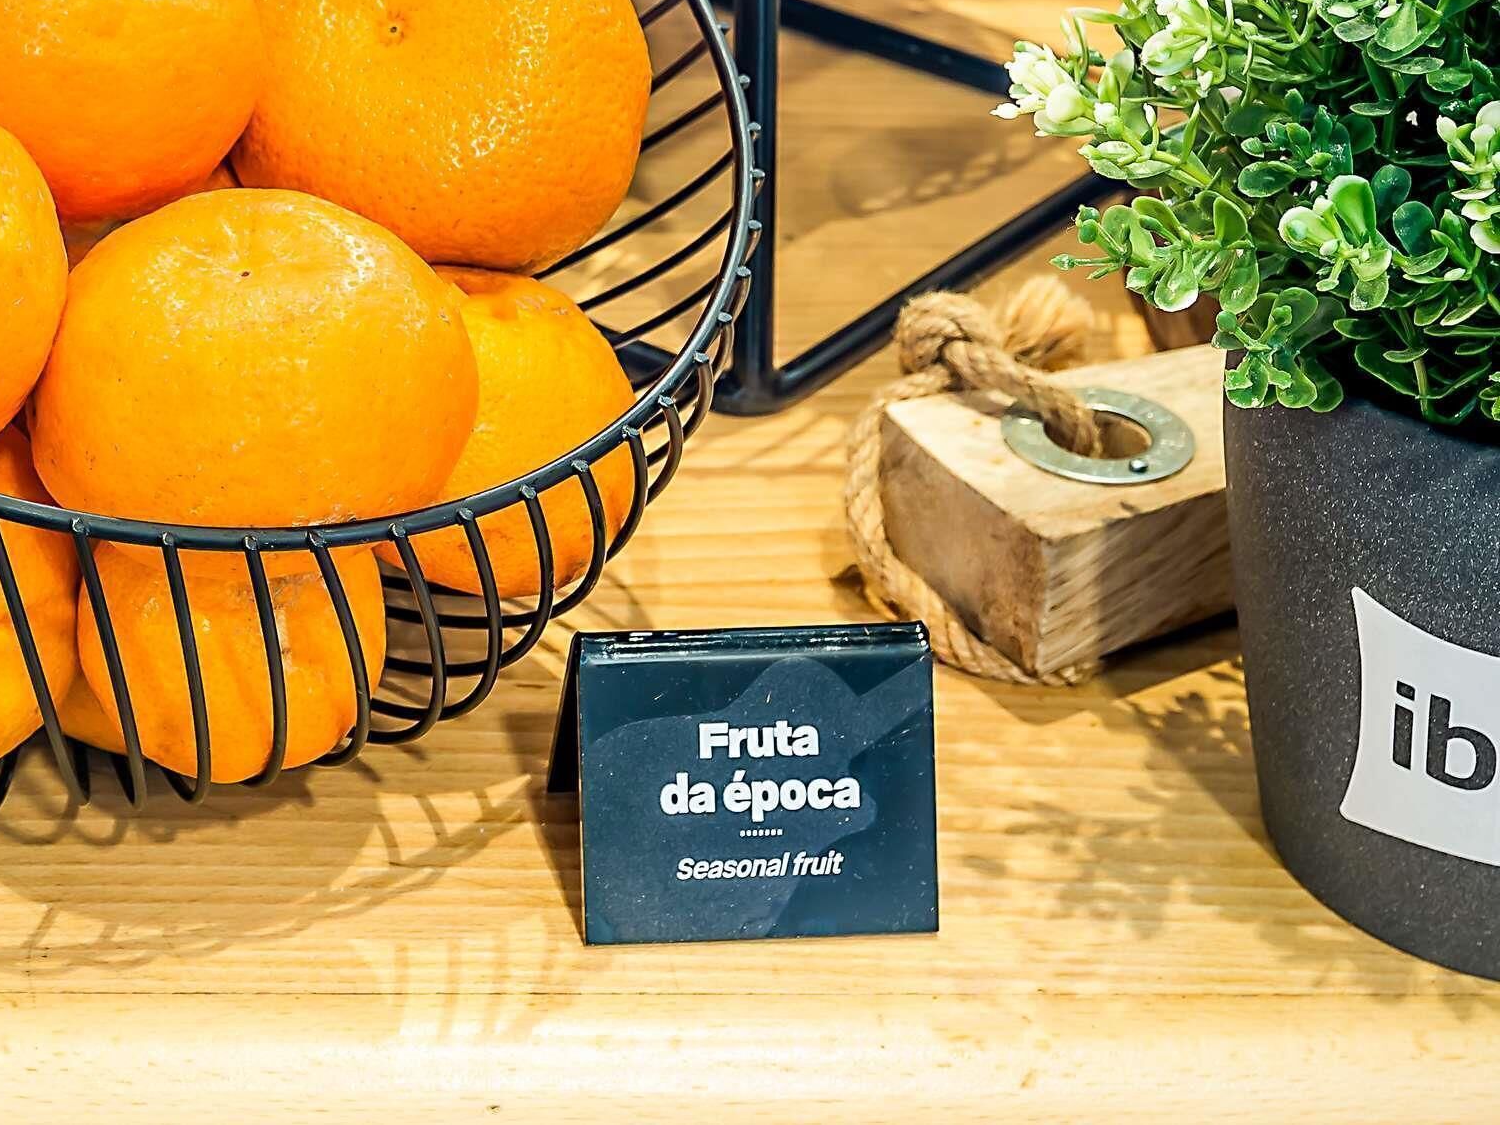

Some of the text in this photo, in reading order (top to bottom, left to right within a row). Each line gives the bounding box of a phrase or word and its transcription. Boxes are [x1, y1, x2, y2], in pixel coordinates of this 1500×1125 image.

[698, 720, 820, 759] Fruta
[659, 769, 862, 823] da época
[675, 849, 845, 881] Seasonal fruit
